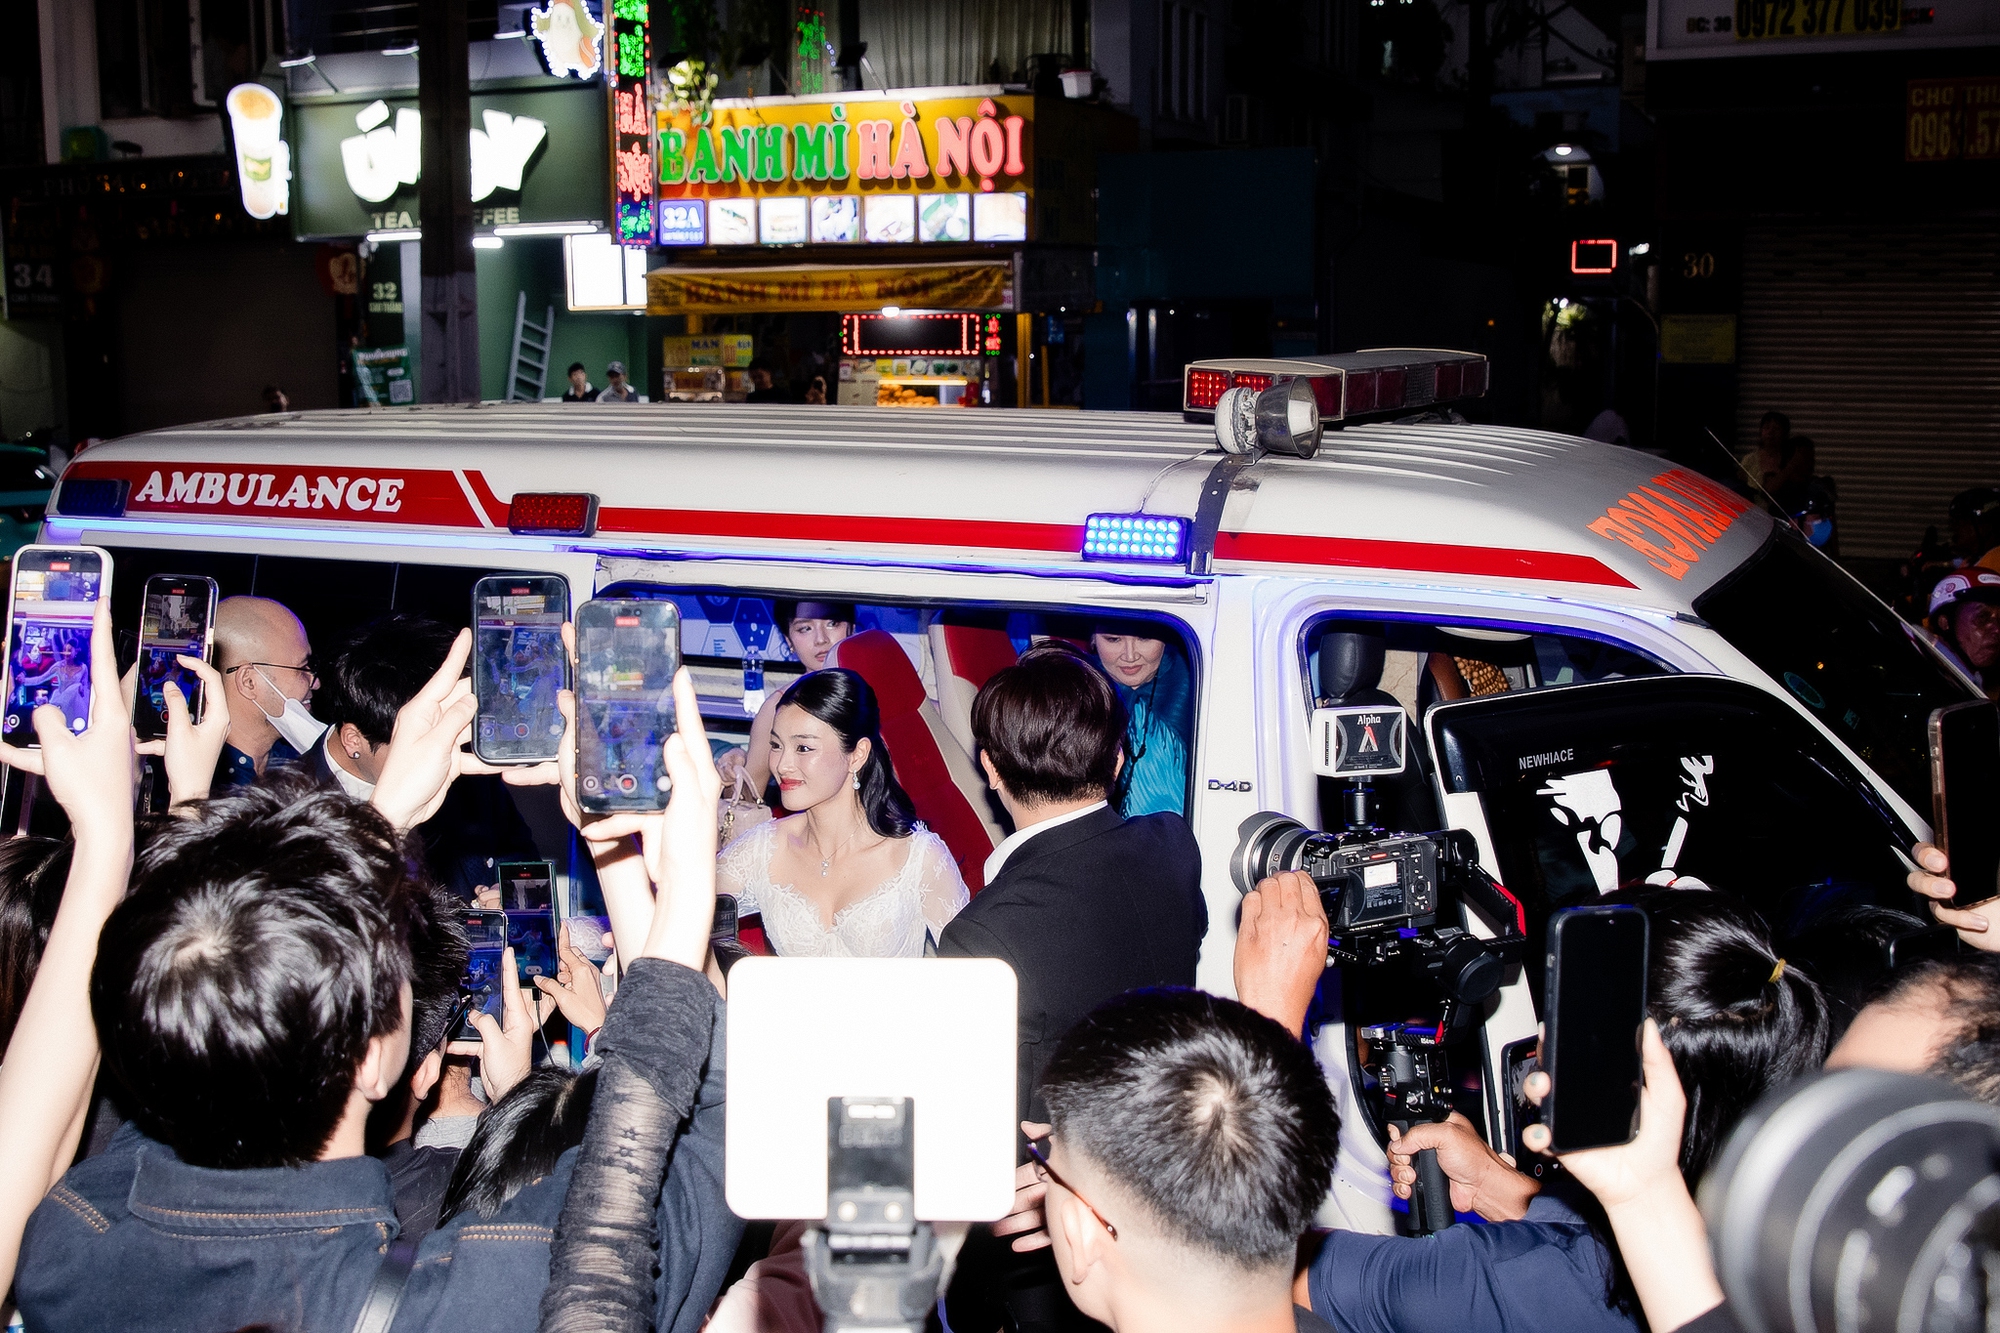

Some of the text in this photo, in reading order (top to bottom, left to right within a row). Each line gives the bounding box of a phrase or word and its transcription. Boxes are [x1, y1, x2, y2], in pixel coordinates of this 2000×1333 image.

[1735, 0, 1795, 37] 0972
[1802, 0, 1844, 34] 377
[1854, 0, 1898, 31] 039
[1910, 86, 1954, 107] CHO
[657, 97, 1025, 193] BÁNH MÌ HÀ NỘI
[371, 211, 414, 229] TEA
[663, 206, 702, 229] 32A
[12, 262, 54, 289] 34
[1683, 252, 1716, 279] 30
[372, 282, 398, 301] 32
[135, 471, 404, 513] AMBULANCE
[1357, 713, 1382, 726] Alpha
[1518, 748, 1575, 770] NEWHIACE
[1208, 779, 1253, 793] D-4D
